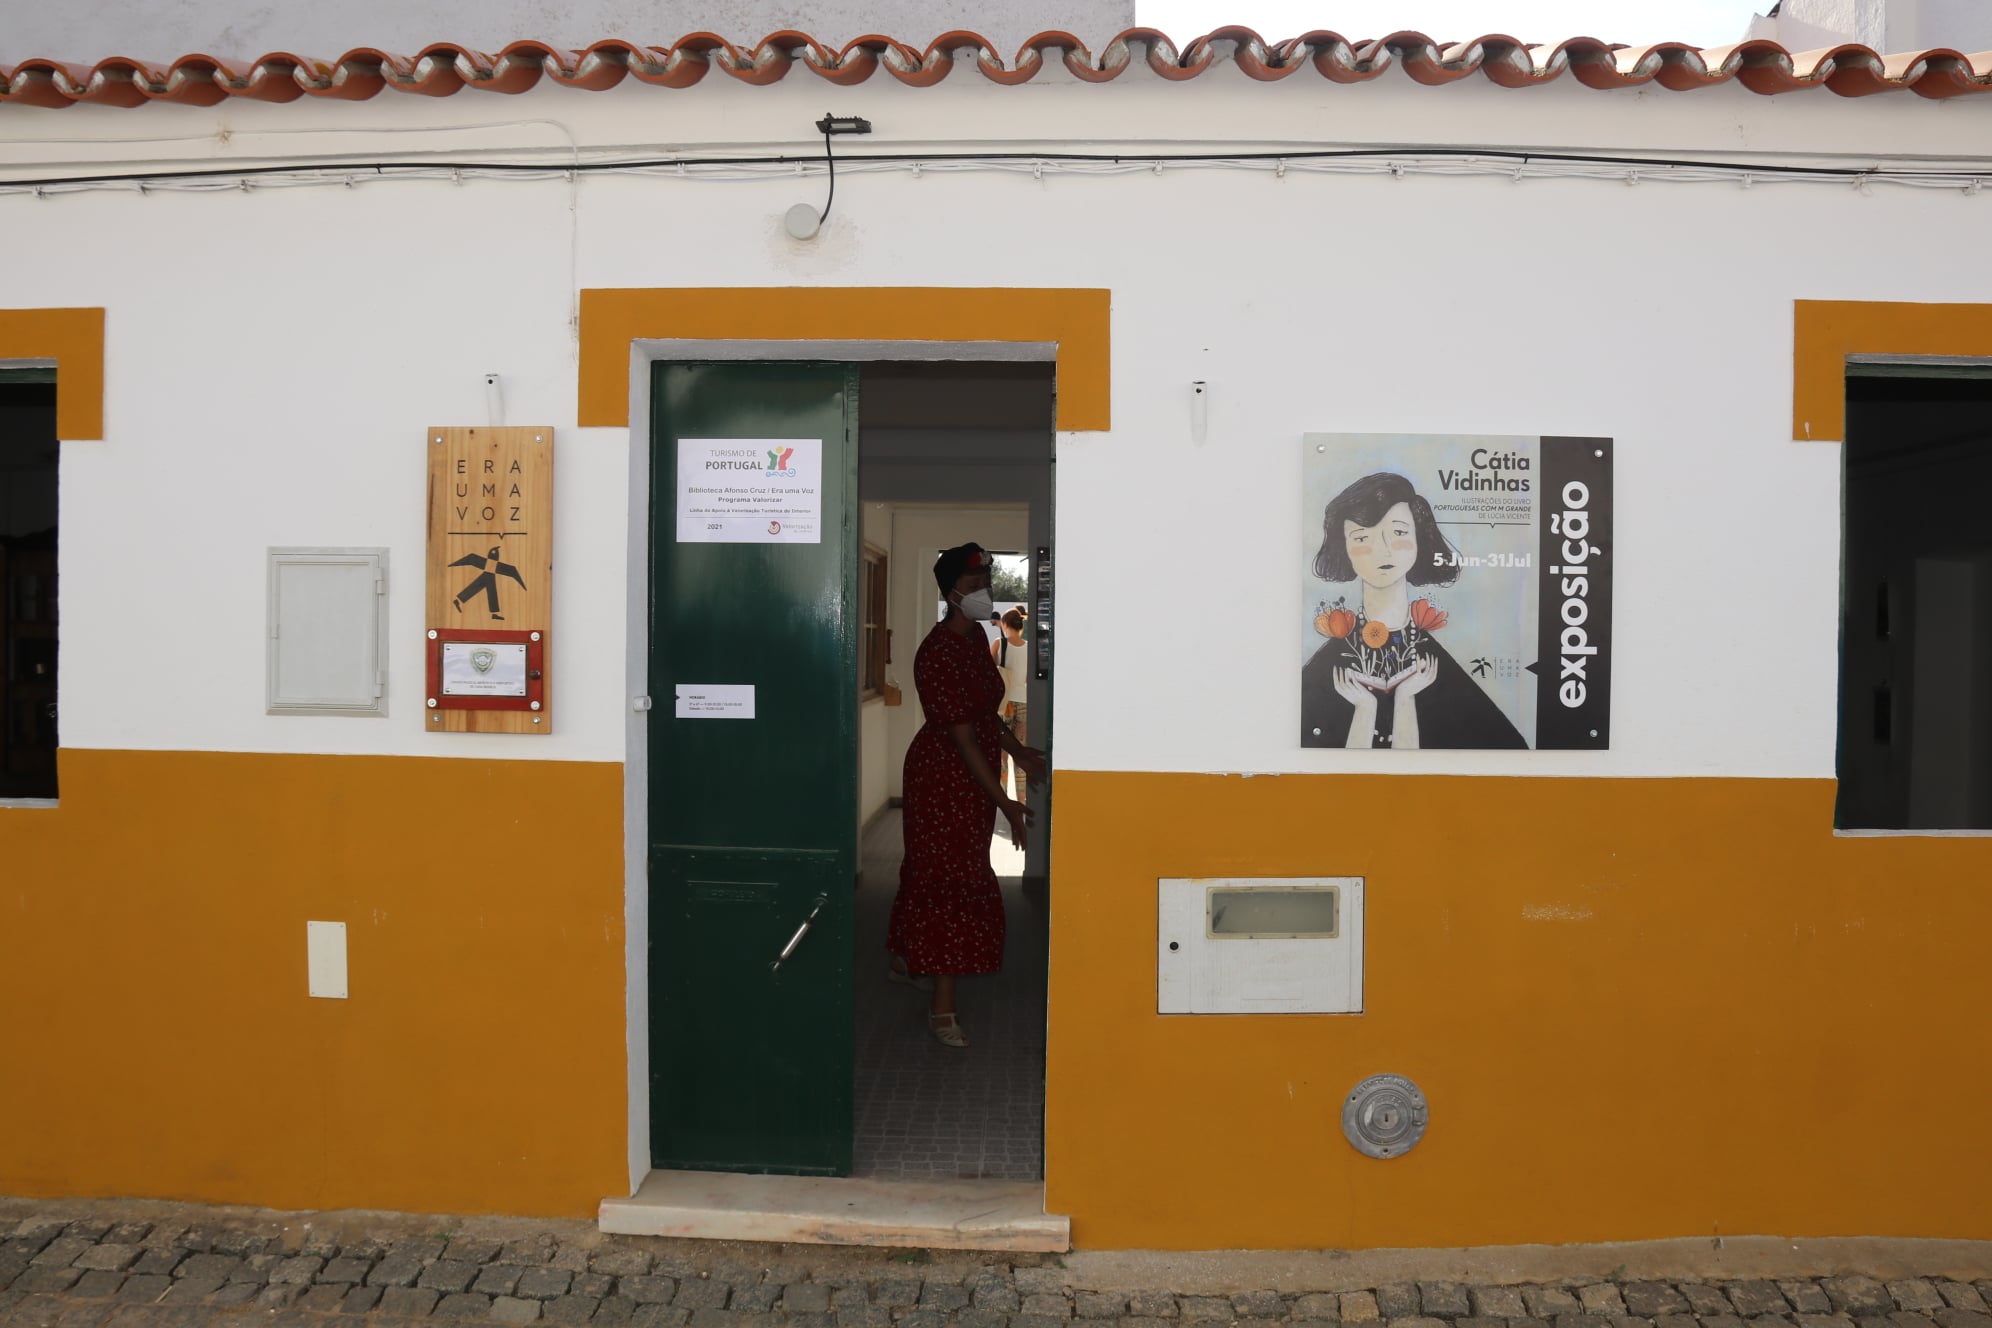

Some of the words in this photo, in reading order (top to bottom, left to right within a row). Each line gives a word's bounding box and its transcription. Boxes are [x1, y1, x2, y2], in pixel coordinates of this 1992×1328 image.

[456, 459, 522, 474] ERA
[705, 461, 763, 470] PORTUGAL
[1471, 448, 1530, 471] Cátia
[1438, 470, 1530, 492] Vidinhas
[456, 483, 521, 498] UMA
[1433, 504, 1479, 512] PORTUGUESAS
[1461, 497, 1501, 506] ILUSTRAÇÕES
[456, 506, 520, 521] VOZ
[1550, 480, 1602, 709] exposição
